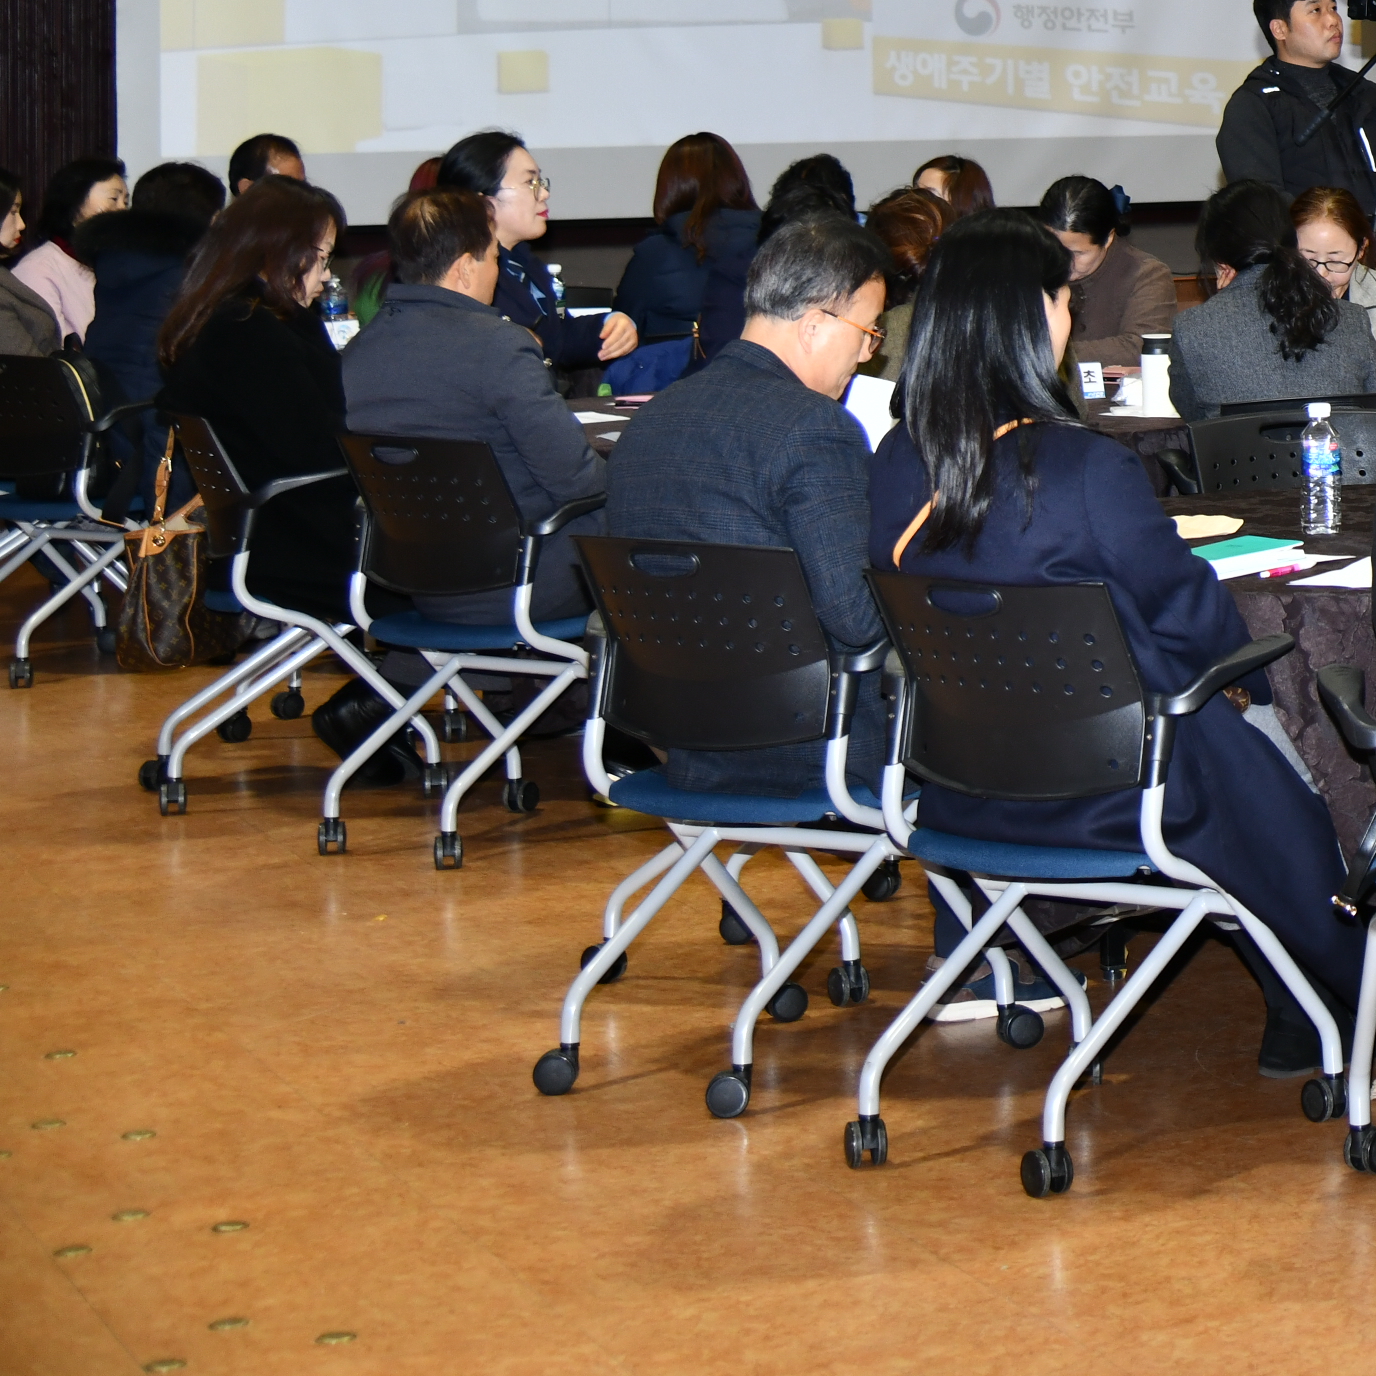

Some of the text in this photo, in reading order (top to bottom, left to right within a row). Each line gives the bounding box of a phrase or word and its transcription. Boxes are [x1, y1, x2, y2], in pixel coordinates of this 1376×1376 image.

[1012, 2, 1137, 35] 행정안전부
[885, 50, 1228, 115] 생애주기별 안전교육
